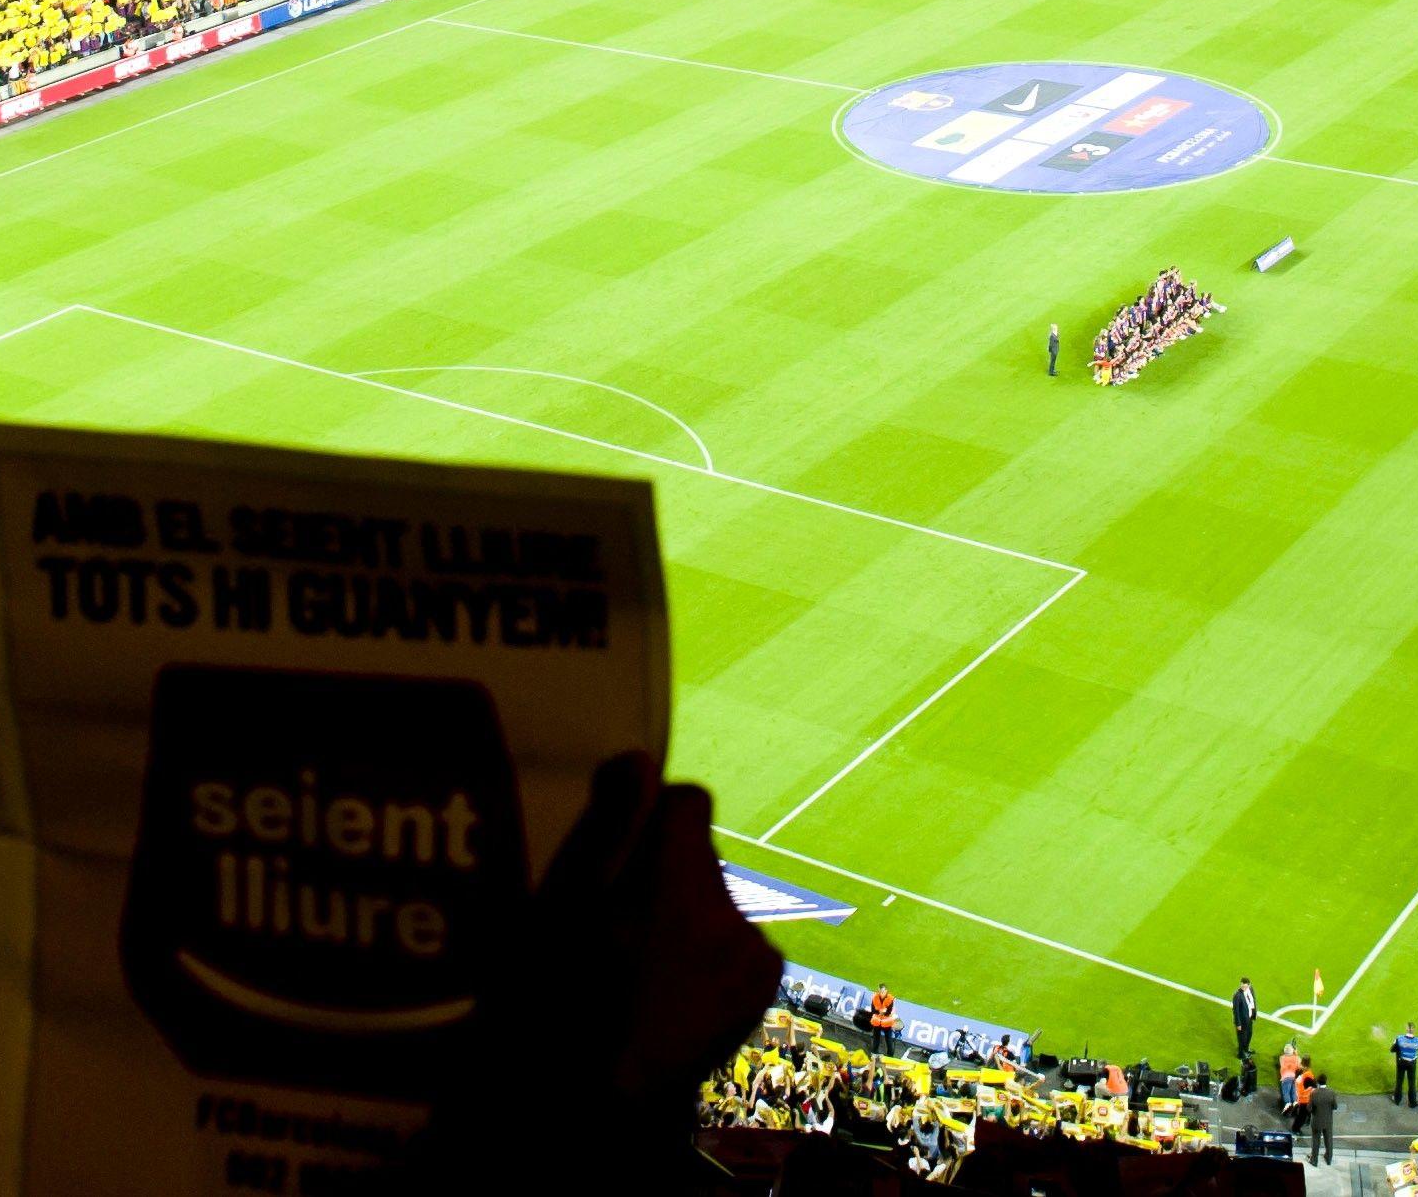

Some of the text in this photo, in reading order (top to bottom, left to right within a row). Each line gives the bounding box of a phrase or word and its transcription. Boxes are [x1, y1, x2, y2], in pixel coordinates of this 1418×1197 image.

[32, 489, 148, 549] AMB
[152, 497, 224, 554] EL
[34, 554, 202, 629] TOTS
[212, 563, 274, 633] HI
[190, 766, 480, 870] seient
[216, 850, 448, 957] lliure
